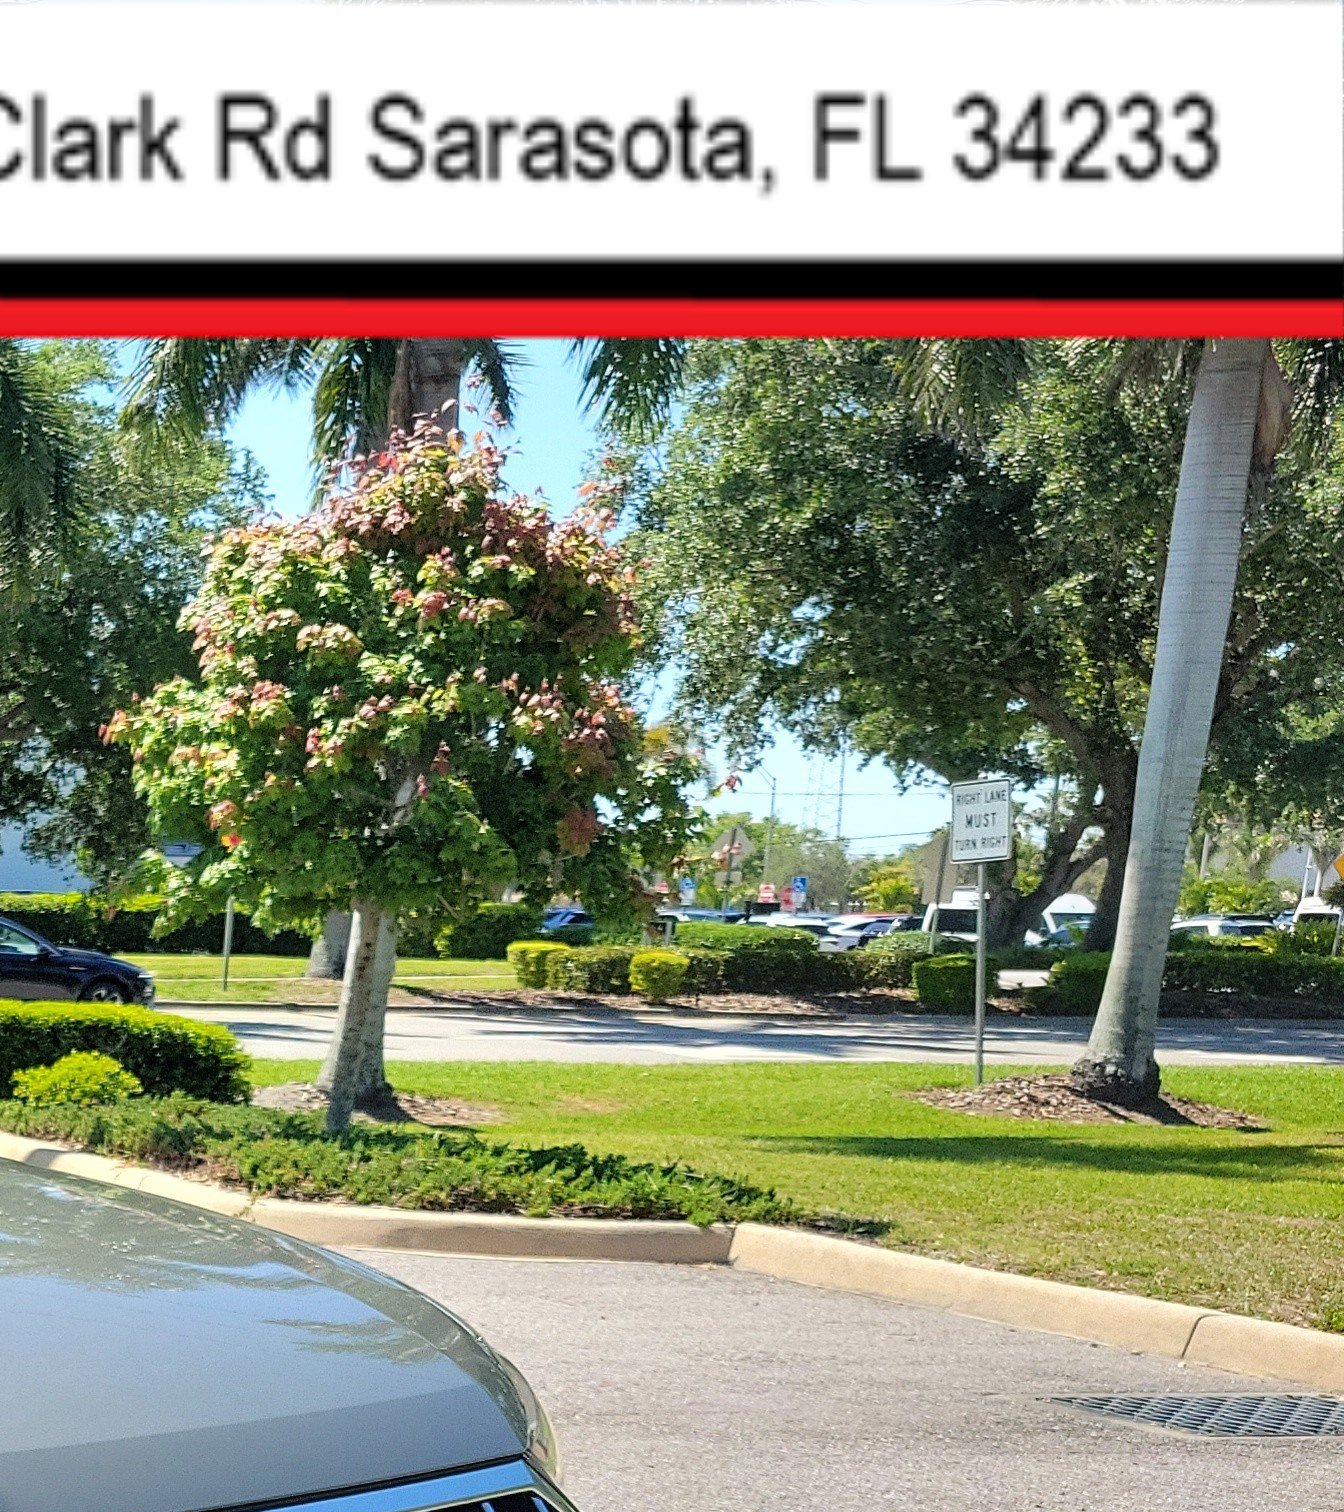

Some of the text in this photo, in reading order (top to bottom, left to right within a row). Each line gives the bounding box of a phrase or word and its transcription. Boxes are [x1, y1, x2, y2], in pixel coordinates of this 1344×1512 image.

[956, 789, 1007, 805] RIGHT LANE
[965, 812, 997, 829] MUST
[955, 835, 1007, 852] TURN RIGHT
